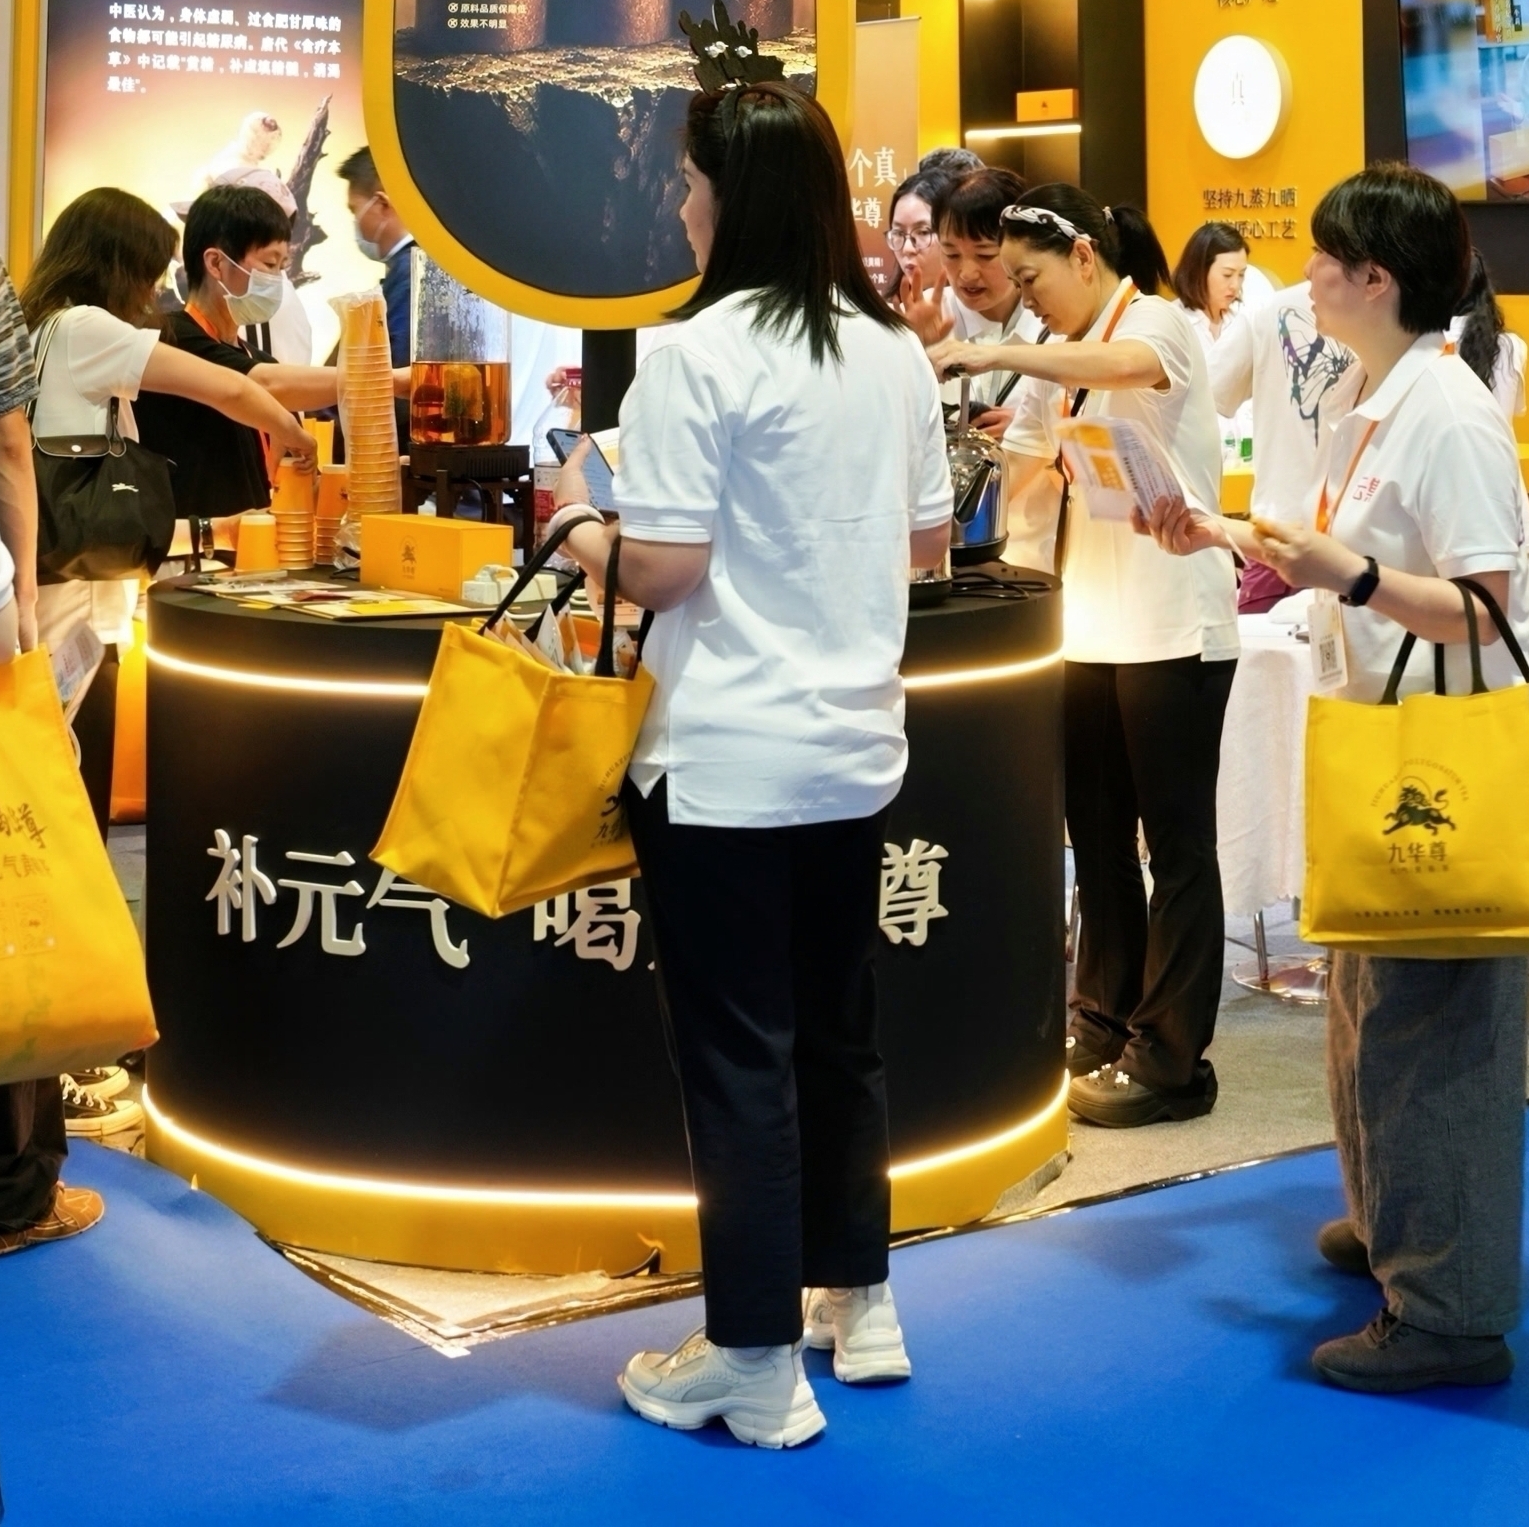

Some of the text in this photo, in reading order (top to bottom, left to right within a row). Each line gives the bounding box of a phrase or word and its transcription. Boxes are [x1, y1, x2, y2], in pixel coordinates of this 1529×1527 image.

[1203, 186, 1298, 210] 坚持九蒸九晒
[1205, 218, 1298, 241] 匠心工艺
[1388, 840, 1448, 864] 九华尊
